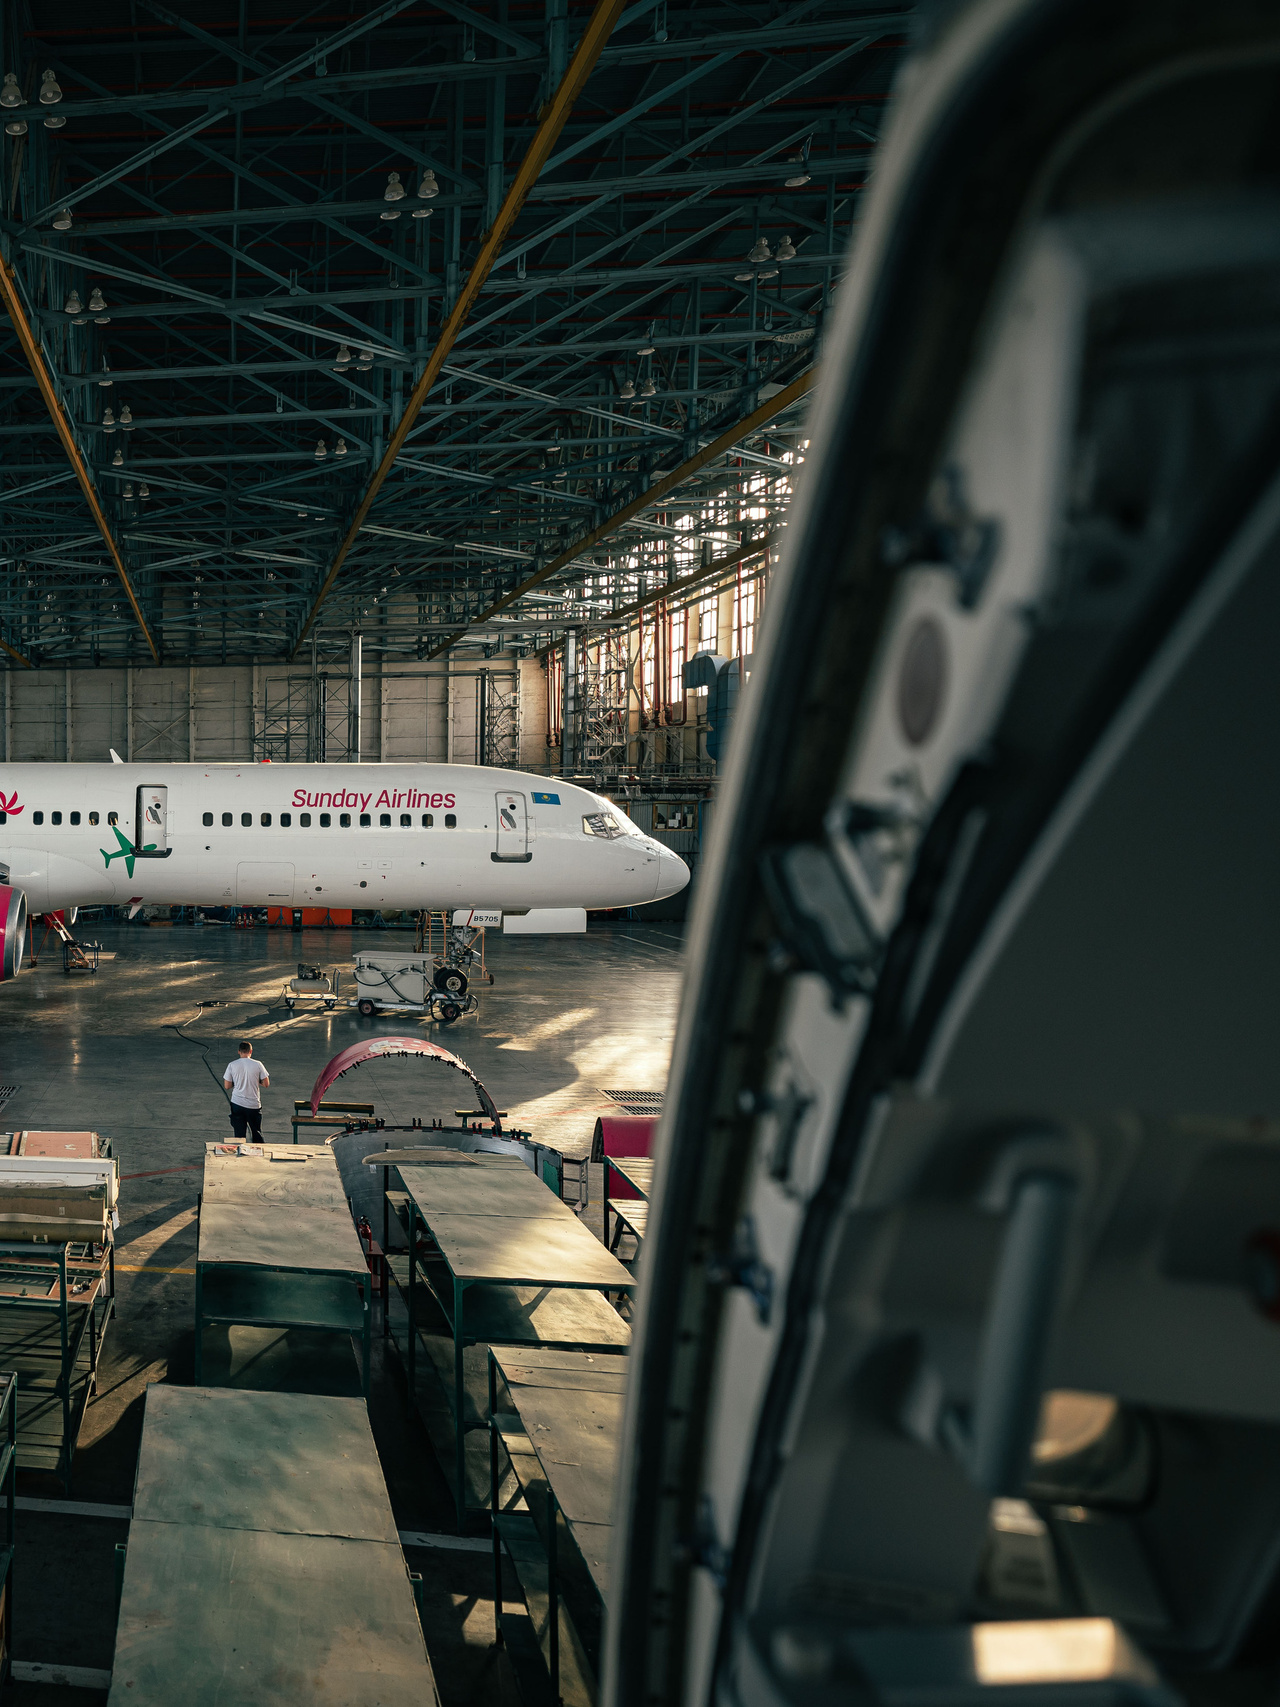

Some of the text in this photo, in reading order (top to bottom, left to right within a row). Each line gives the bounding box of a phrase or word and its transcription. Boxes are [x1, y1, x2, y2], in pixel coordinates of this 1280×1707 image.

[291, 788, 456, 813] Sunday Airlines
[473, 915, 499, 923] B5705
